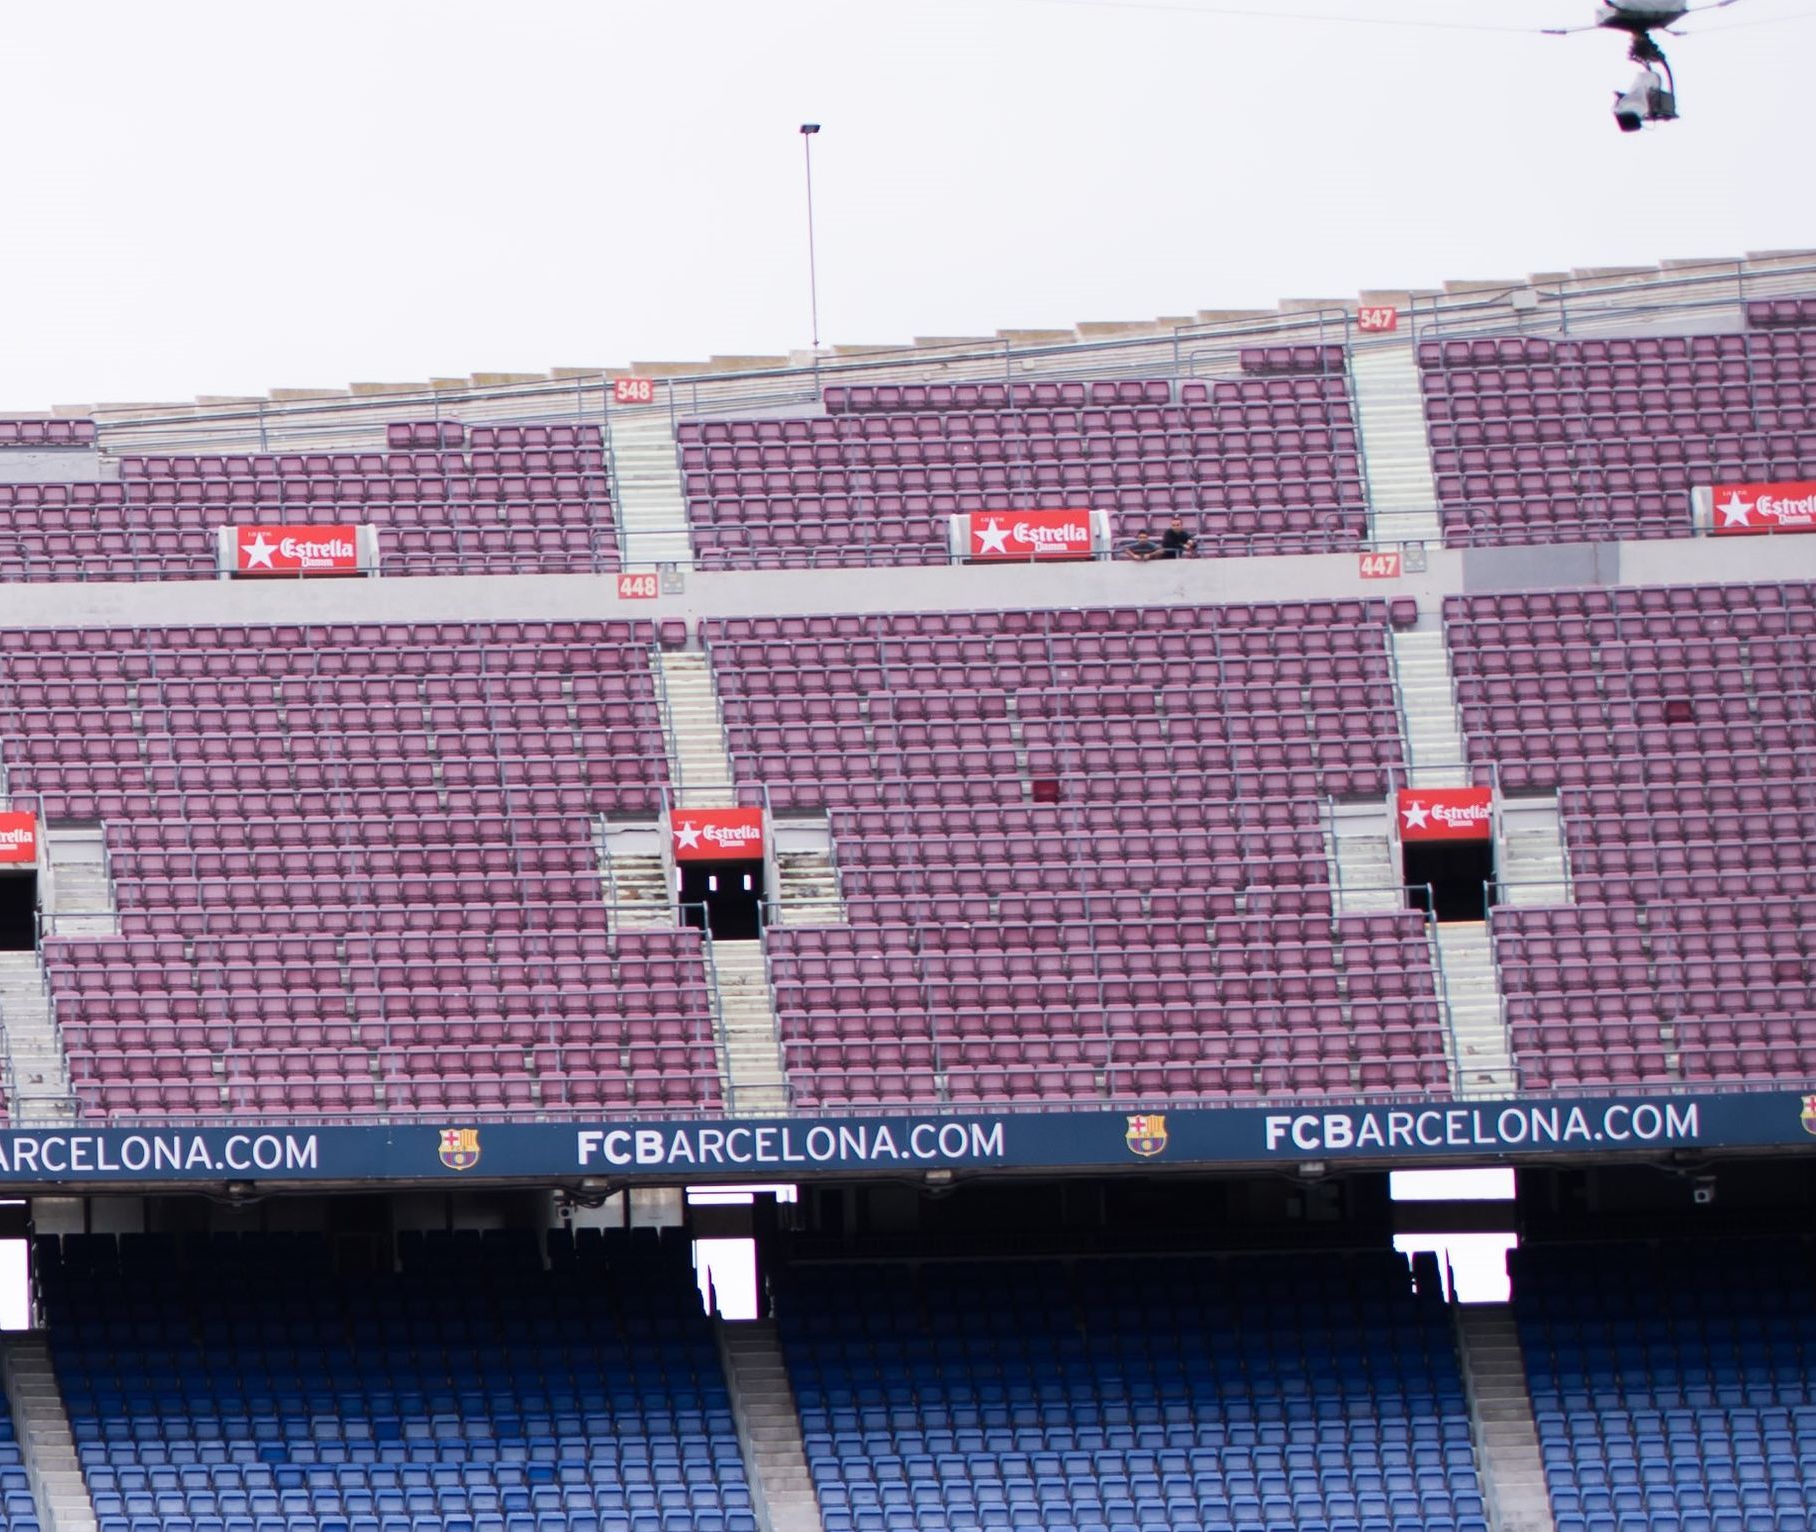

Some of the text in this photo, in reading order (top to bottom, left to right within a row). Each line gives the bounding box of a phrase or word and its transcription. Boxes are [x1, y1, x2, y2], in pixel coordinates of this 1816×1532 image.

[1361, 309, 1393, 329] 547
[617, 381, 650, 400] 548
[1013, 522, 1087, 543] Estrella
[280, 537, 354, 558] Estrella
[1361, 556, 1397, 575] 447
[620, 576, 656, 596] 448
[1431, 803, 1488, 821] Estrella
[703, 825, 760, 841] Estrella
[1267, 1103, 1698, 1150] FCBARCELONA.COM
[578, 1122, 1004, 1165] FCBARCELONA.COM
